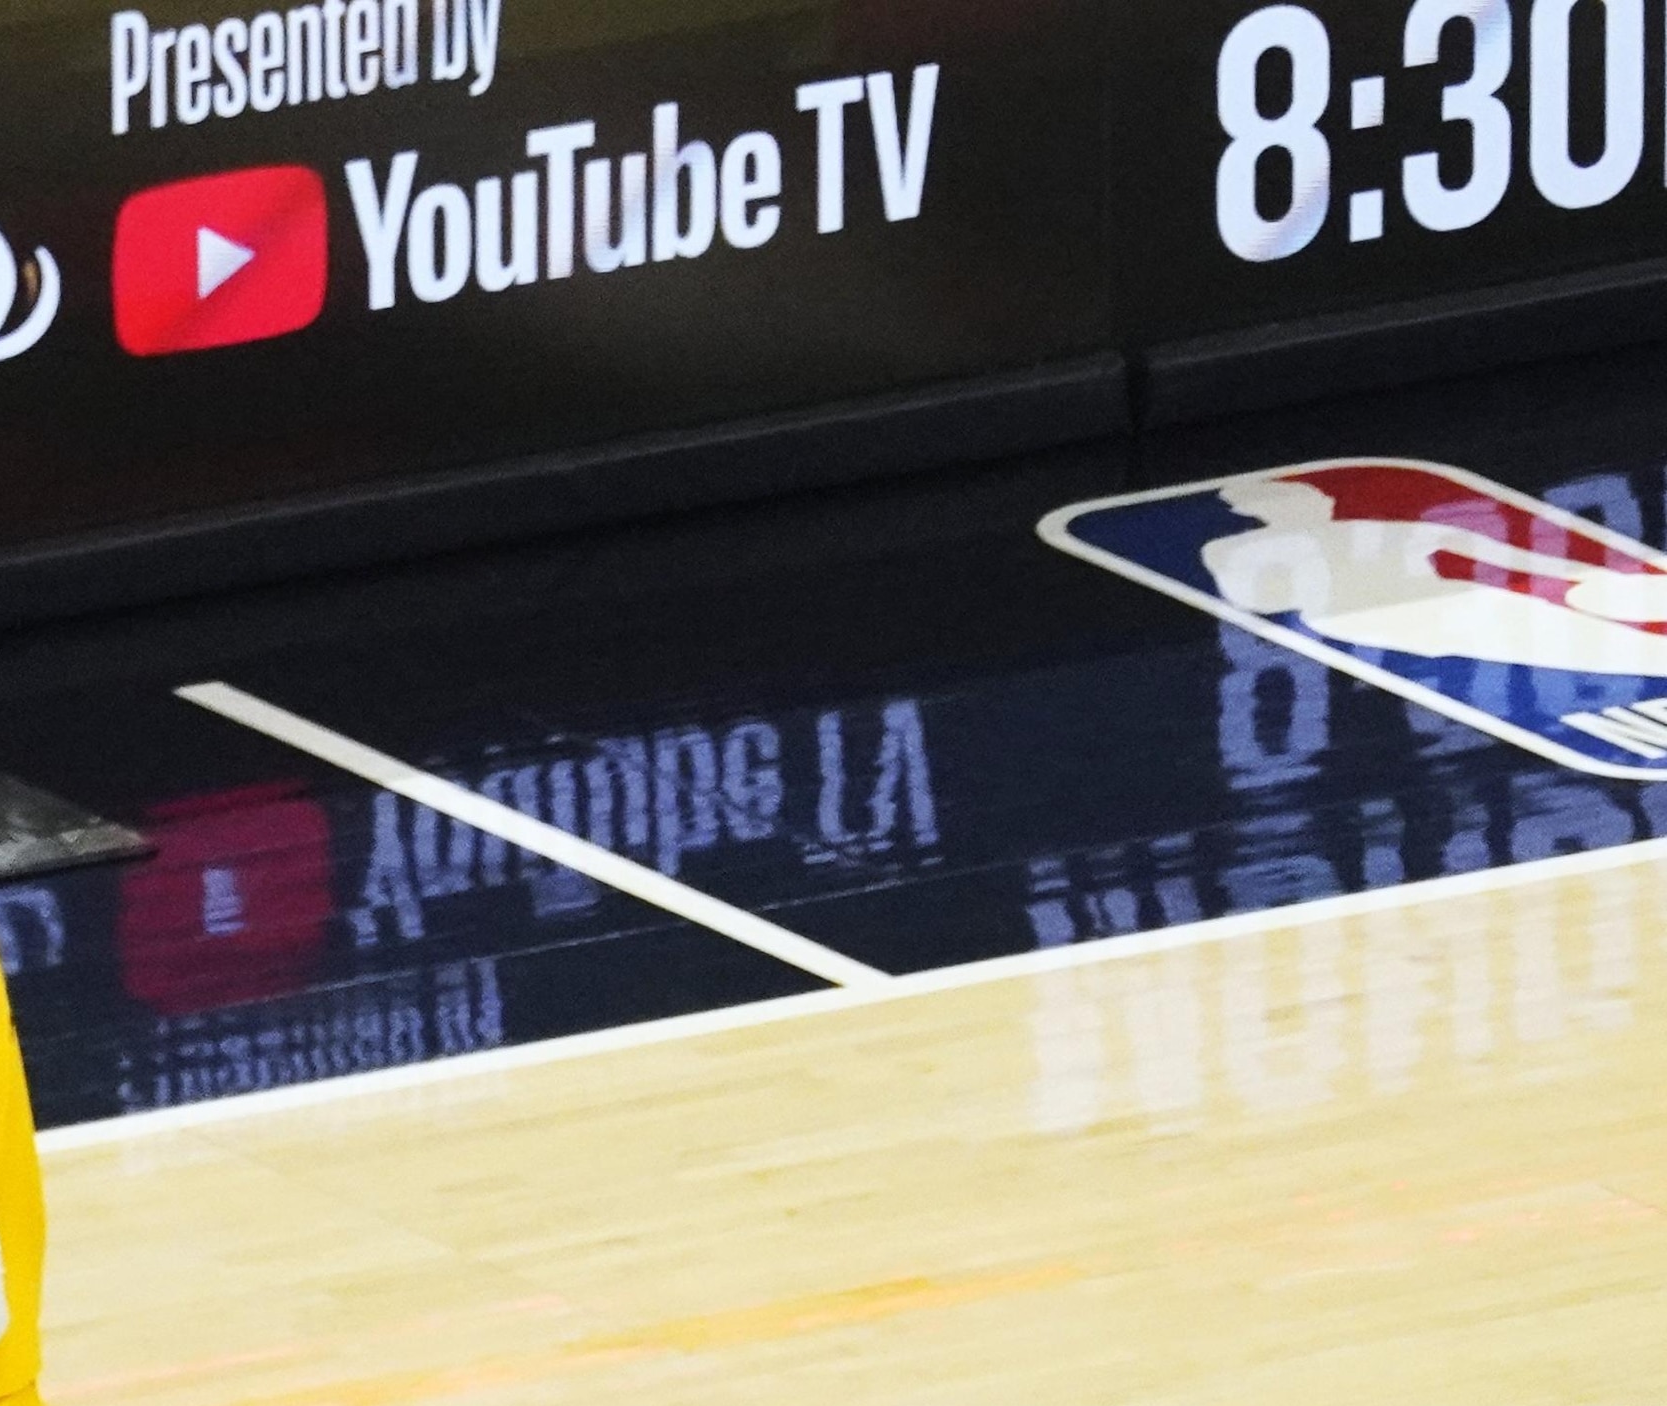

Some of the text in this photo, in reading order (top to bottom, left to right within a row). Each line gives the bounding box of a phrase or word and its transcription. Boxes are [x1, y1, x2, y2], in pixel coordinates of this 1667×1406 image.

[110, 0, 419, 136] Presented
[344, 63, 941, 312] YouTube TV
[1216, 0, 1667, 262] 8:30
